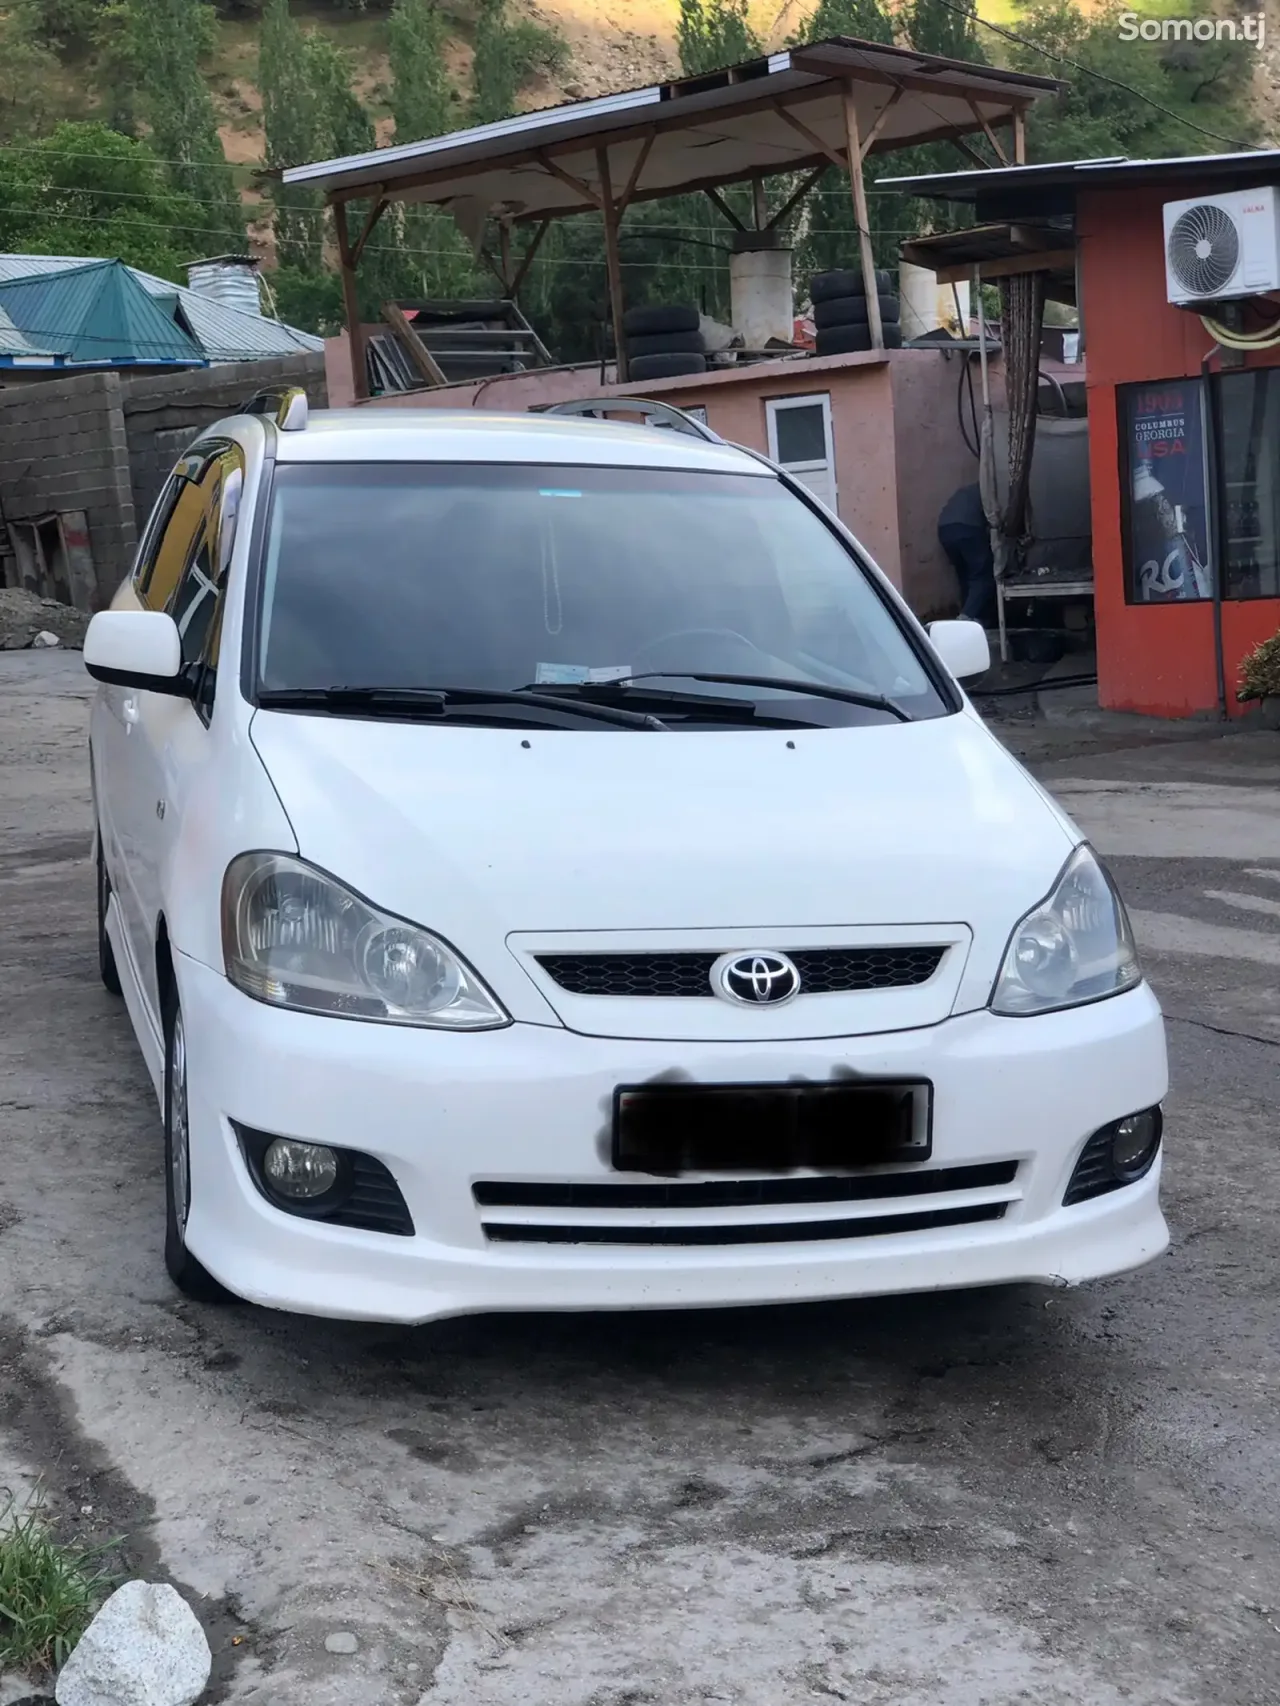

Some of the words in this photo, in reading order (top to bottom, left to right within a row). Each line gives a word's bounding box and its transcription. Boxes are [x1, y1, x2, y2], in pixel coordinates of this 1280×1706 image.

[1135, 418, 1185, 431] COLUMBUS
[1135, 428, 1185, 441] GEORGIA
[1137, 440, 1186, 459] USA
